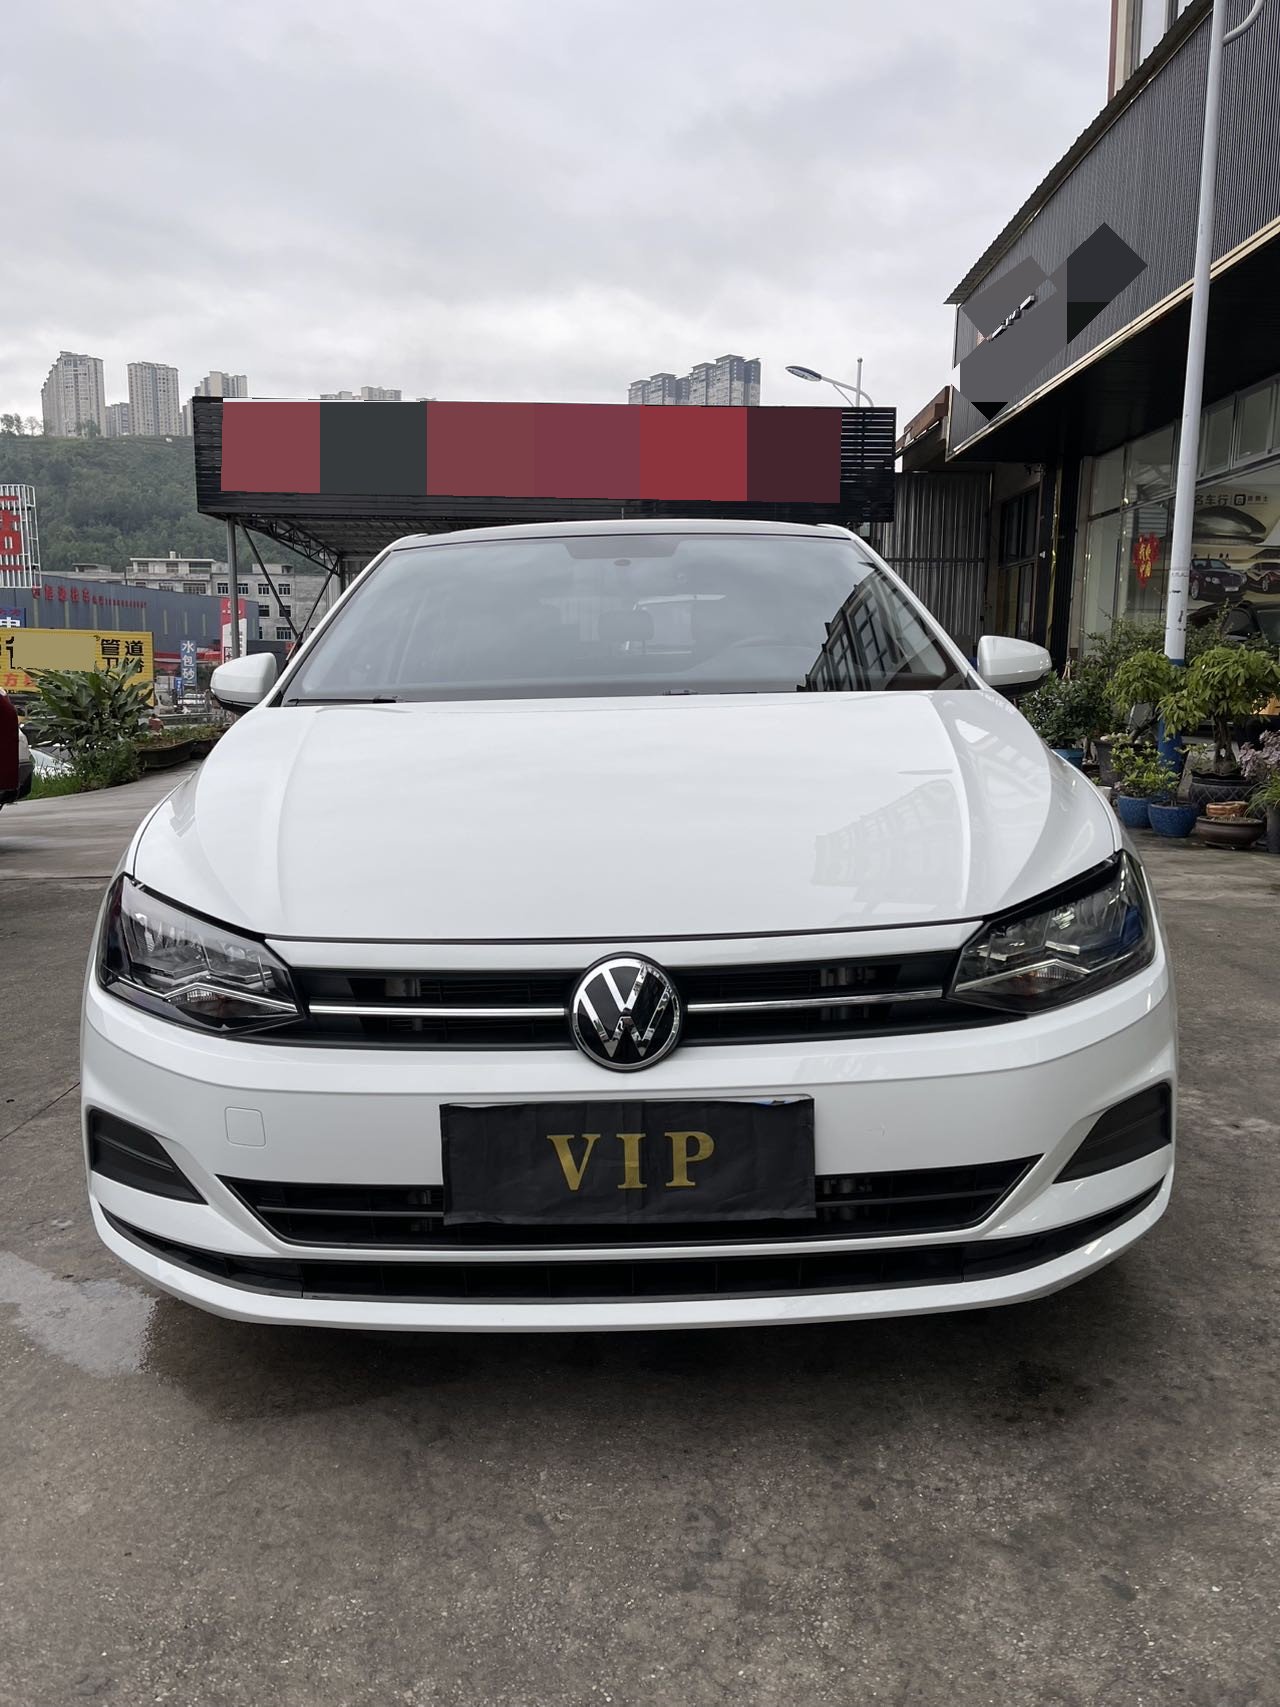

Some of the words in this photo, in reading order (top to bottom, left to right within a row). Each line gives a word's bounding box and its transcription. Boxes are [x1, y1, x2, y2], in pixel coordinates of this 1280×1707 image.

[101, 638, 144, 656] 管道
[182, 640, 195, 680] 水包砂
[546, 1130, 715, 1191] VIP
